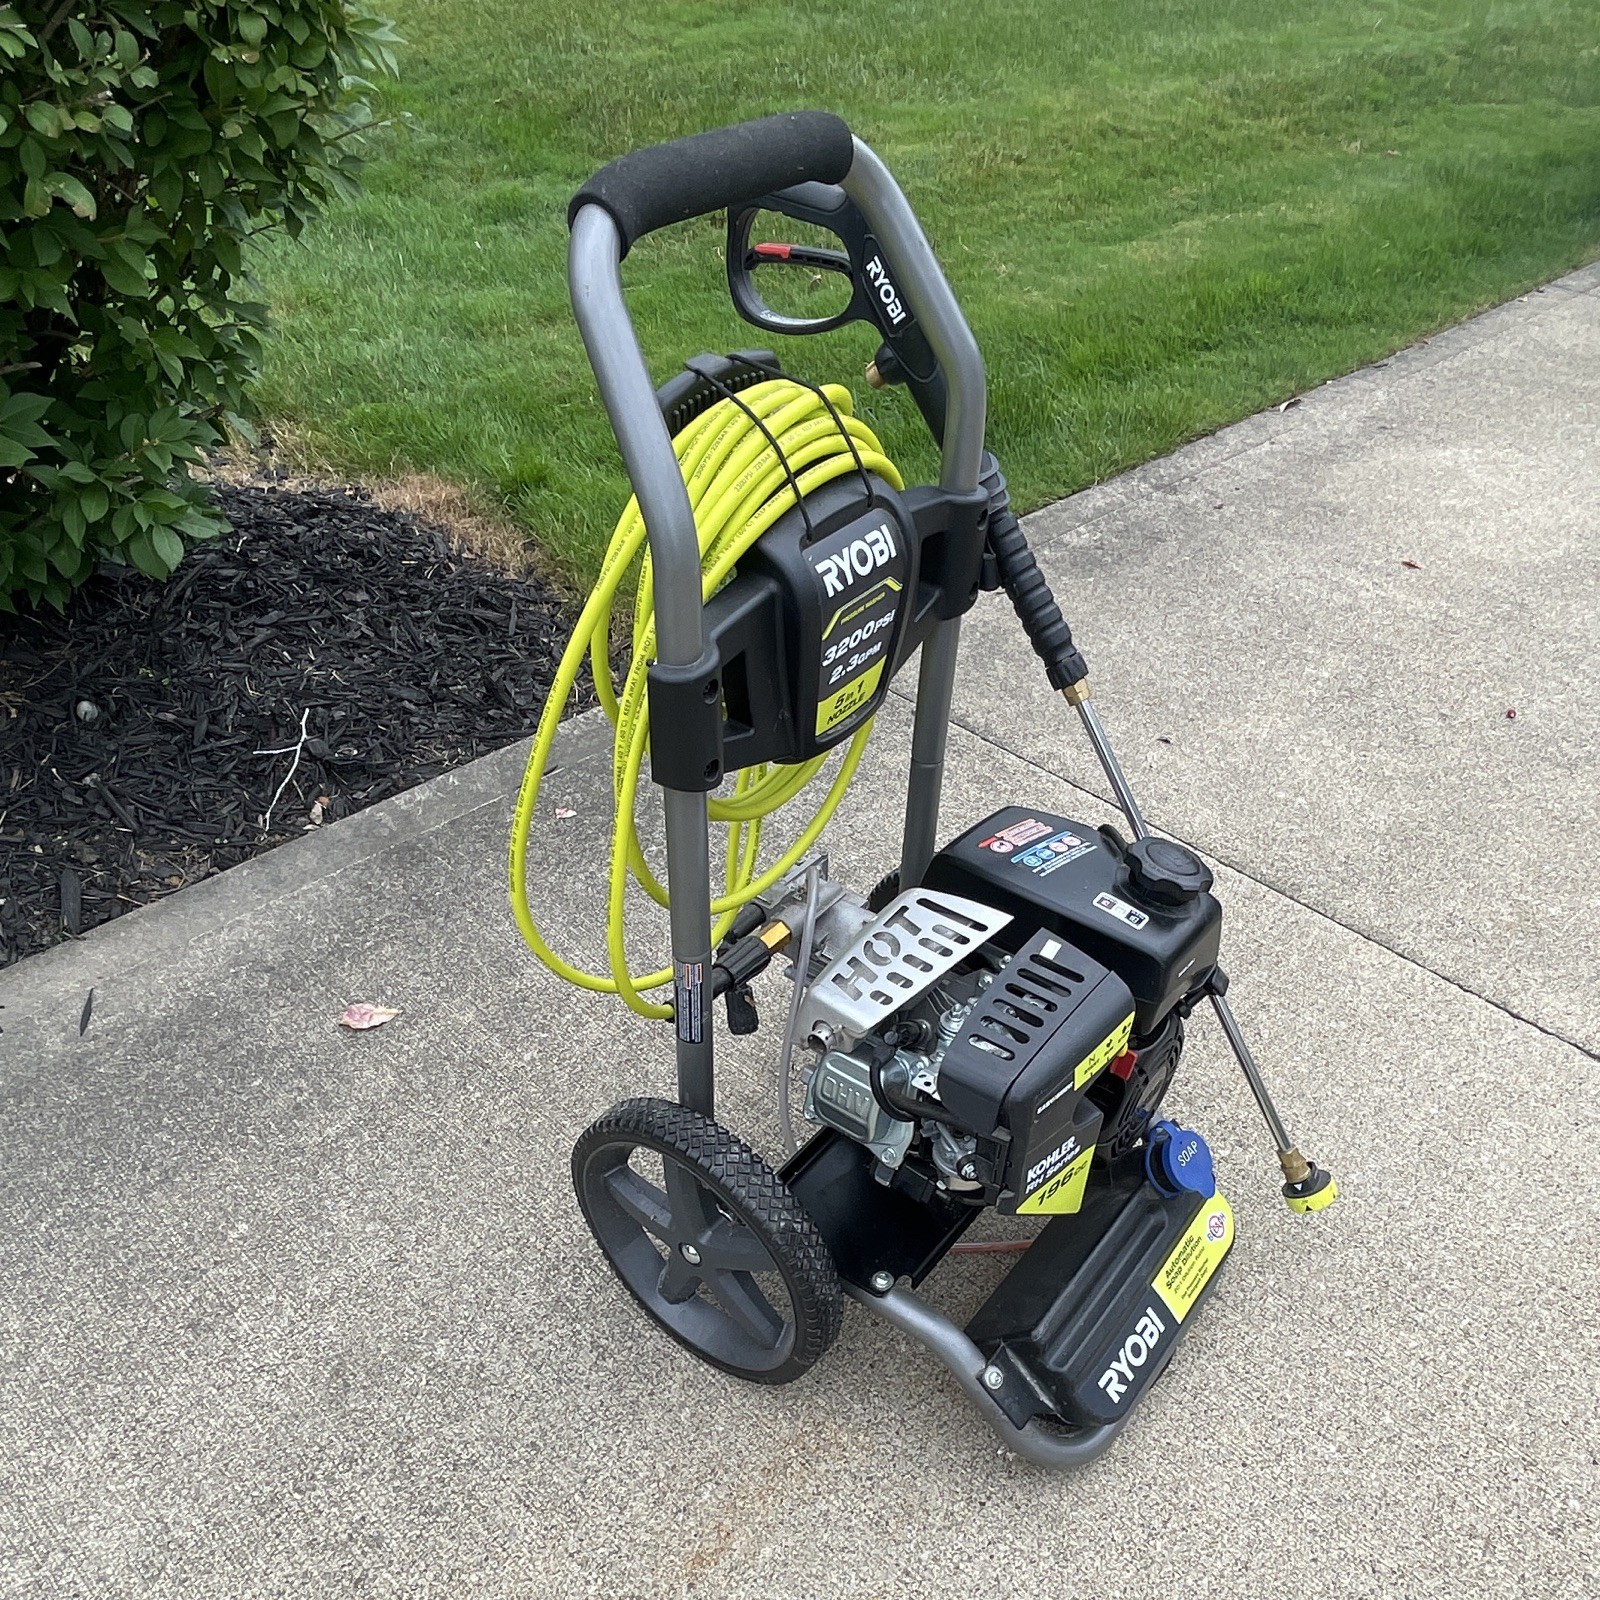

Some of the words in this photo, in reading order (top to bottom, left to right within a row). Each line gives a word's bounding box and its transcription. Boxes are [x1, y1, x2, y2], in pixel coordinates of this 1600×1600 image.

[866, 255, 906, 325] RYOBI
[815, 524, 897, 598] RYOBI
[623, 699, 632, 716] KEEP
[634, 654, 644, 675] FROM
[643, 636, 652, 653] HOT
[827, 692, 865, 725] NOZZLE
[831, 905, 922, 1001] HOT
[1027, 1136, 1075, 1183] KOHLER
[1046, 1145, 1081, 1178] Series
[1178, 1140, 1198, 1167] SOAP
[1165, 1235, 1194, 1279] Automatic
[1166, 1267, 1183, 1290] Soap
[1182, 1236, 1202, 1266] Dilution
[1098, 1307, 1165, 1403] RYOBI
